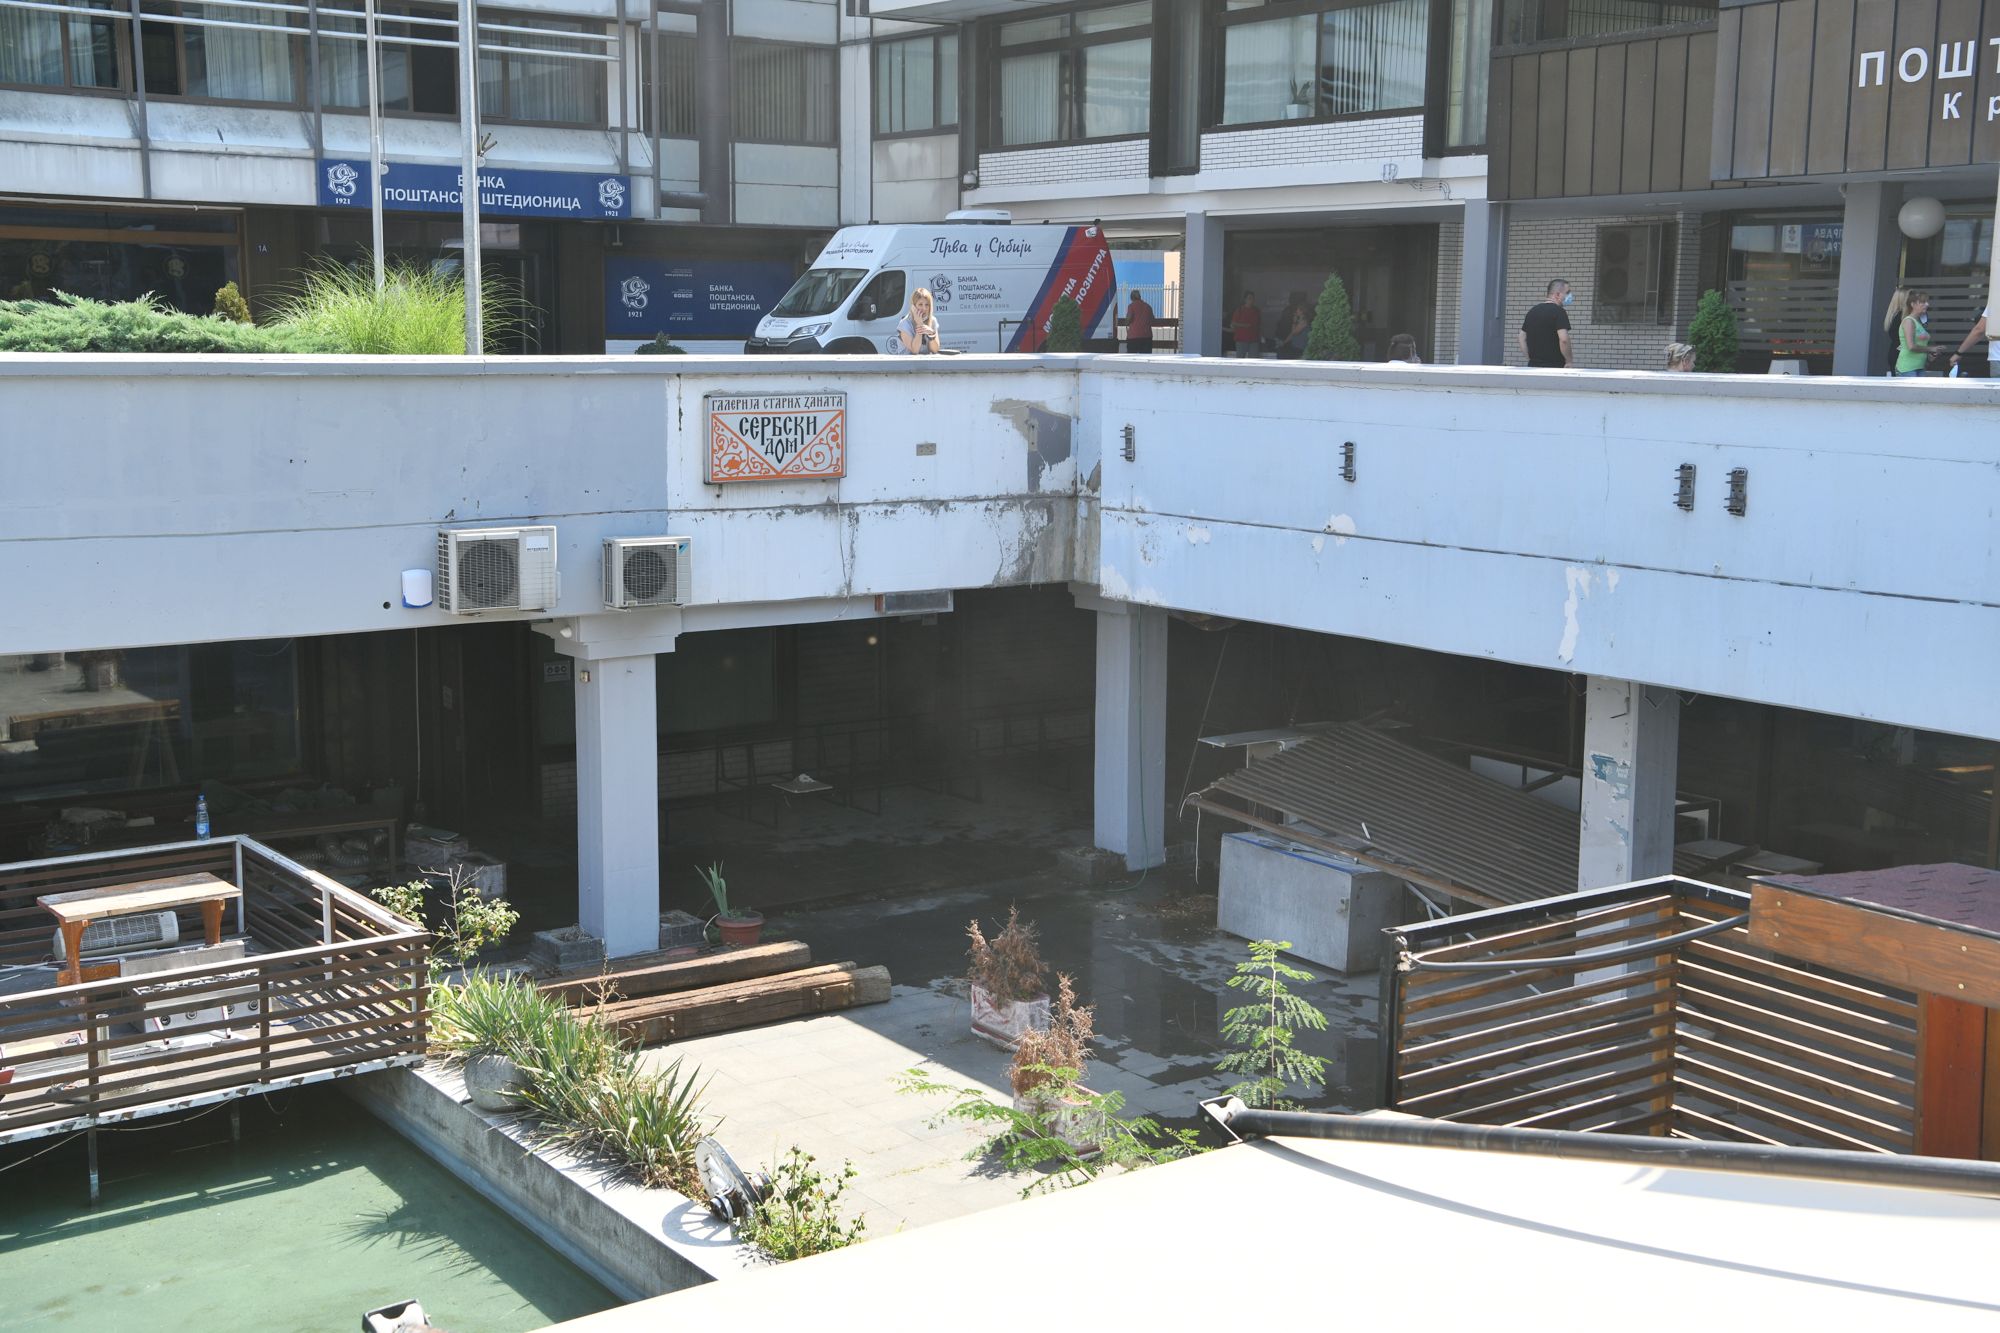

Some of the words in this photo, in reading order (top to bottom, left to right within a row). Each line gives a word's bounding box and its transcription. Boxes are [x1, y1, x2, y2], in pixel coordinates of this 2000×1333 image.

[457, 174, 506, 189] БНКА
[335, 197, 351, 205] 1921
[385, 187, 464, 204] ПОШТАНС
[481, 192, 582, 211] ШТЕДИОНИЦА
[930, 237, 968, 258] Прва
[974, 243, 982, 258] у
[989, 236, 1032, 258] Србији
[709, 284, 734, 292] БАНКА
[709, 293, 755, 301] ПОШТАНСКА
[958, 293, 1002, 301] ШТЕДИОНИЦА
[709, 302, 761, 311] ШТЕДИОНИЦА
[764, 437, 798, 464] ДОМ
